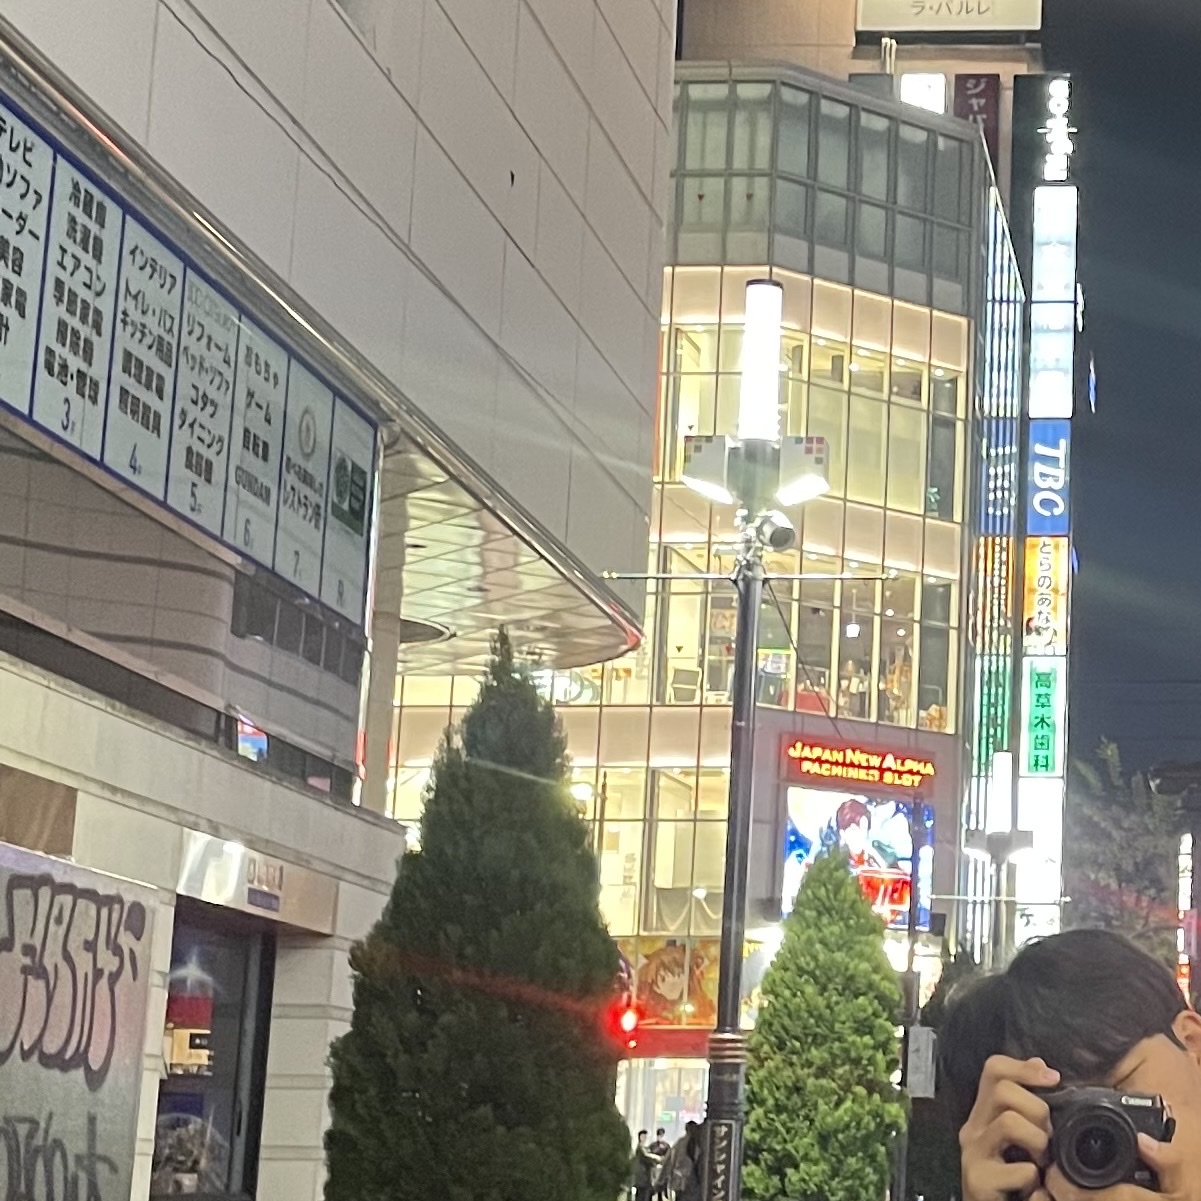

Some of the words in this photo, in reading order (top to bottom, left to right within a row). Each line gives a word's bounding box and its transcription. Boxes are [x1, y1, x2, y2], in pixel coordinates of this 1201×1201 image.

[0, 154, 42, 210] ソファ
[69, 177, 107, 229] 冷蔵庫
[66, 212, 103, 265] 洗濯機
[57, 243, 106, 297] エアコン
[130, 244, 177, 295] インテリア
[53, 275, 103, 338] 季節家電
[120, 308, 173, 368] キッチン用品
[187, 313, 231, 368] リフォーム
[190, 383, 218, 418] コタツ
[246, 387, 271, 426] ゲーム
[178, 408, 225, 456] ダイニング
[1033, 439, 1067, 517] TBC
[1033, 672, 1052, 772] 高草木歯科
[788, 741, 844, 763] JAPAN
[845, 748, 882, 768] NEW
[882, 753, 935, 776] ALPHA
[882, 771, 923, 787] SLOT
